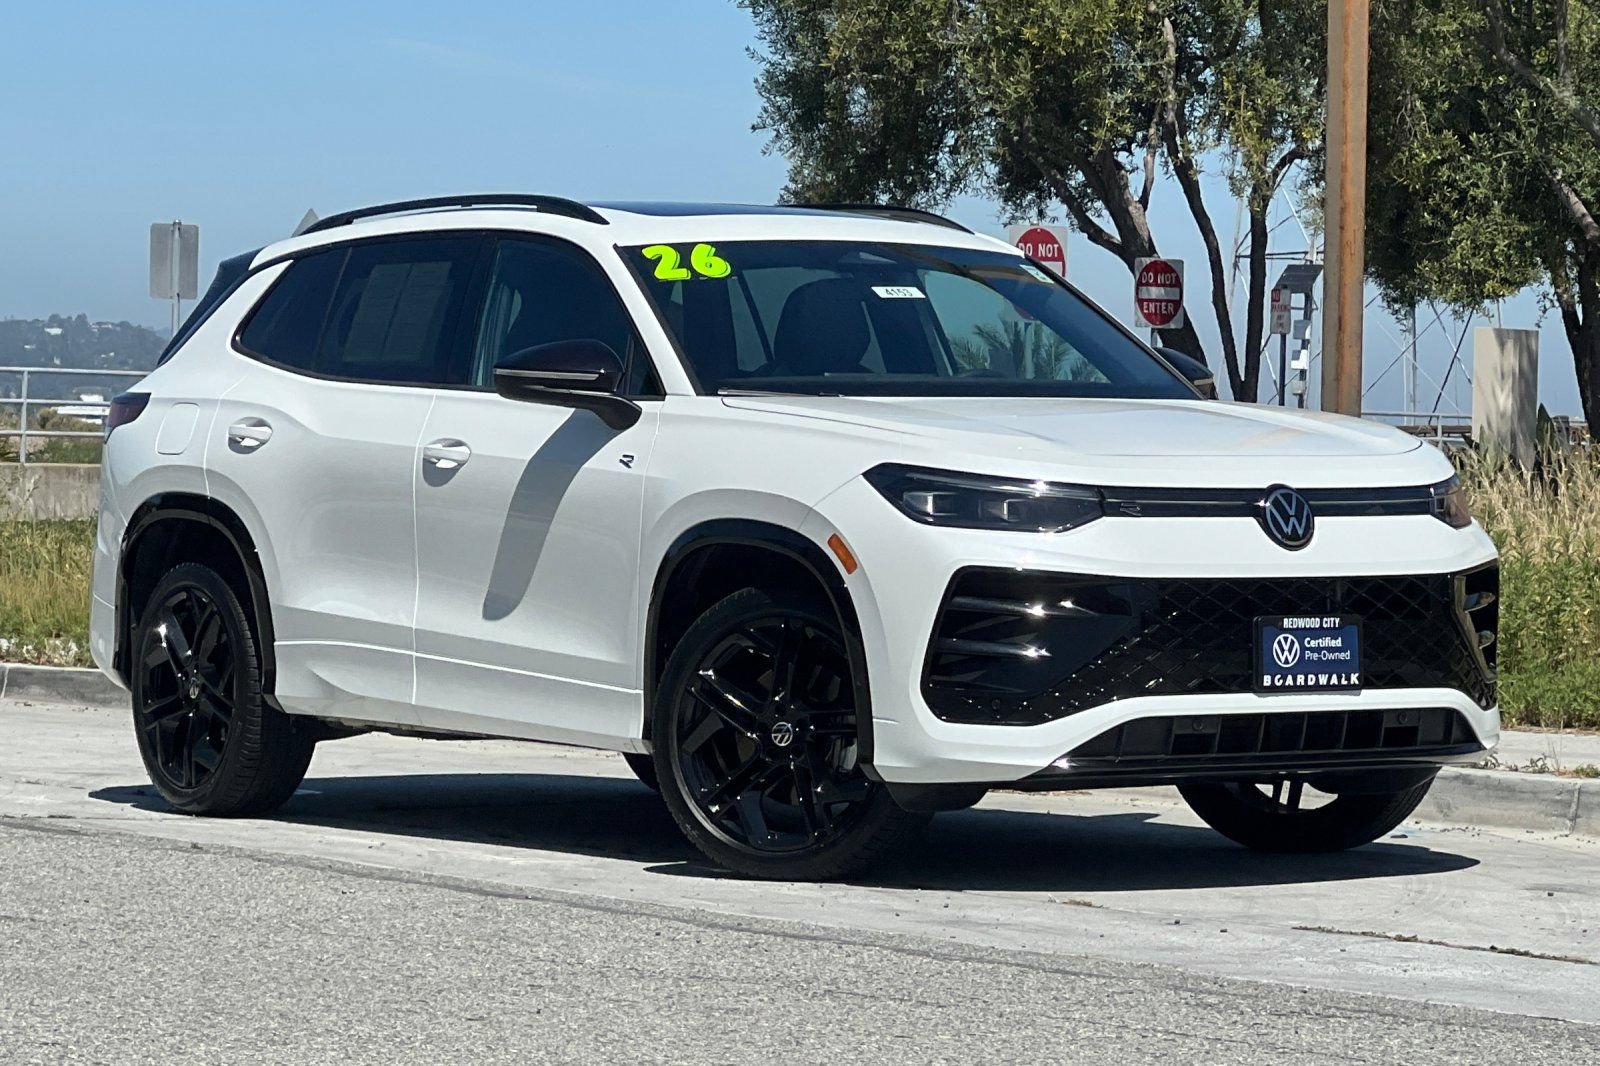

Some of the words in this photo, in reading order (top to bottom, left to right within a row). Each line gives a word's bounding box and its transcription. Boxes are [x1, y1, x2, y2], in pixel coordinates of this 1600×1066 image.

[1018, 243, 1033, 257] DO
[1038, 243, 1059, 258] NOT
[641, 243, 731, 281] 26
[1141, 271, 1154, 284] DO
[1158, 273, 1177, 285] NOT
[885, 288, 913, 297] 4153
[1143, 301, 1175, 315] ENTER
[1283, 617, 1320, 629] REDWOOD
[1322, 617, 1340, 628] CITY
[1304, 636, 1342, 648] Certified
[1305, 649, 1351, 661] Pre-Owned
[1263, 673, 1360, 687] BOARDWALK
